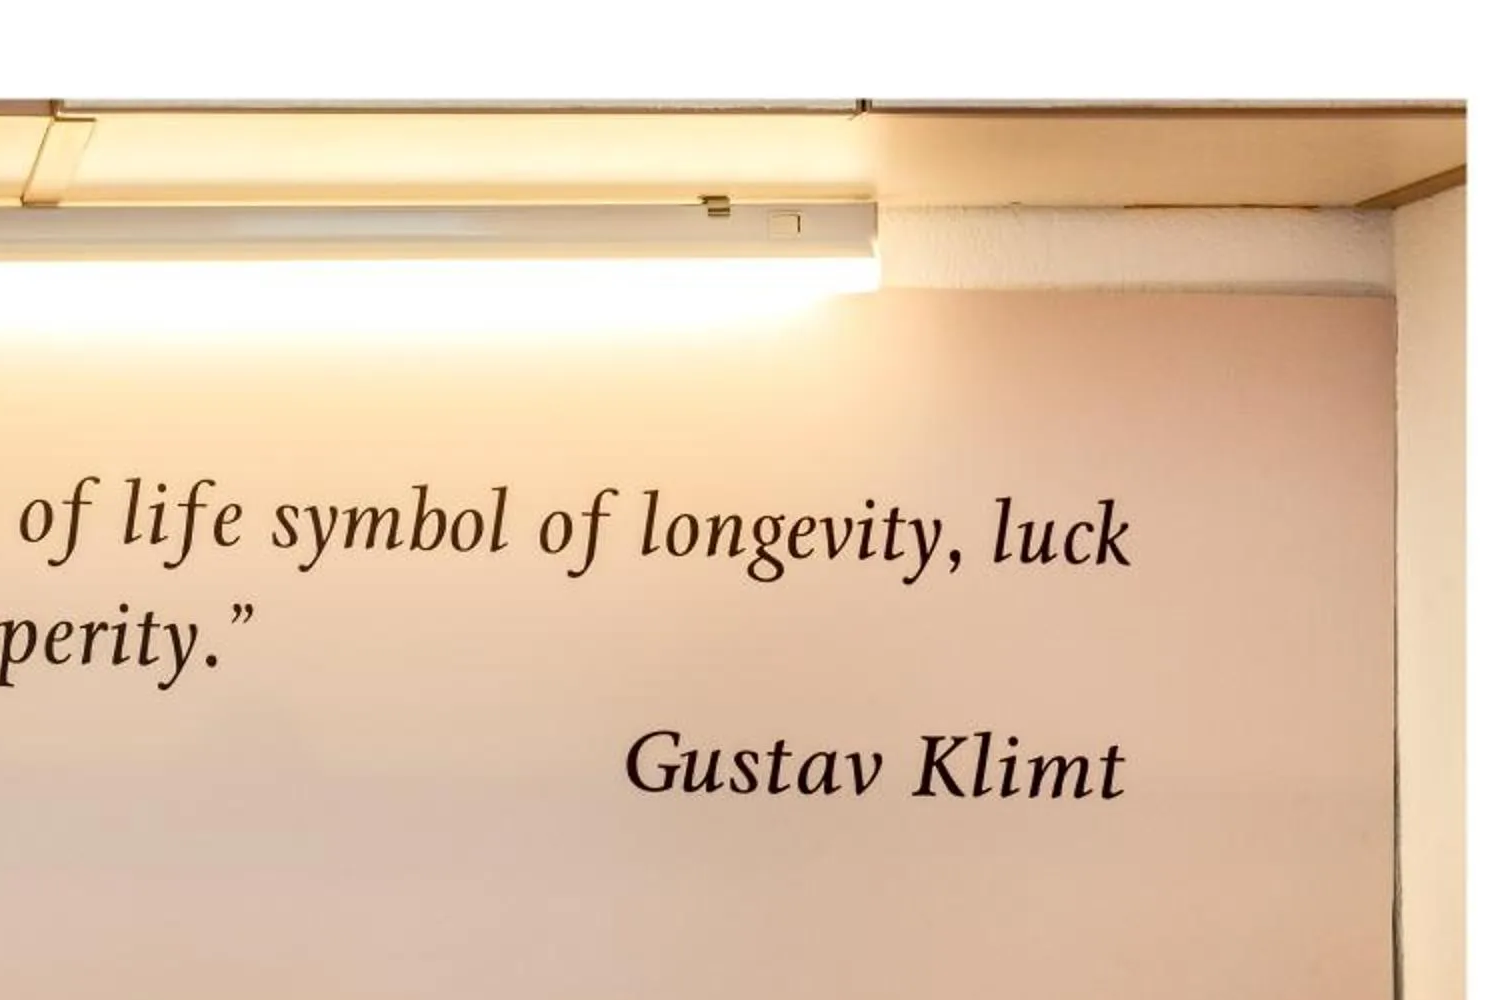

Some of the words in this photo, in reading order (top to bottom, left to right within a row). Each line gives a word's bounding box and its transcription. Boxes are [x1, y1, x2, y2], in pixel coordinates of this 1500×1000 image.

[19, 475, 101, 568] of
[123, 476, 243, 571] life
[271, 483, 509, 574] symbol
[539, 487, 620, 579] of
[641, 489, 962, 587] longevity,
[993, 495, 1132, 567] luck
[625, 729, 884, 797] Gustav
[911, 730, 1127, 801] Klimt
